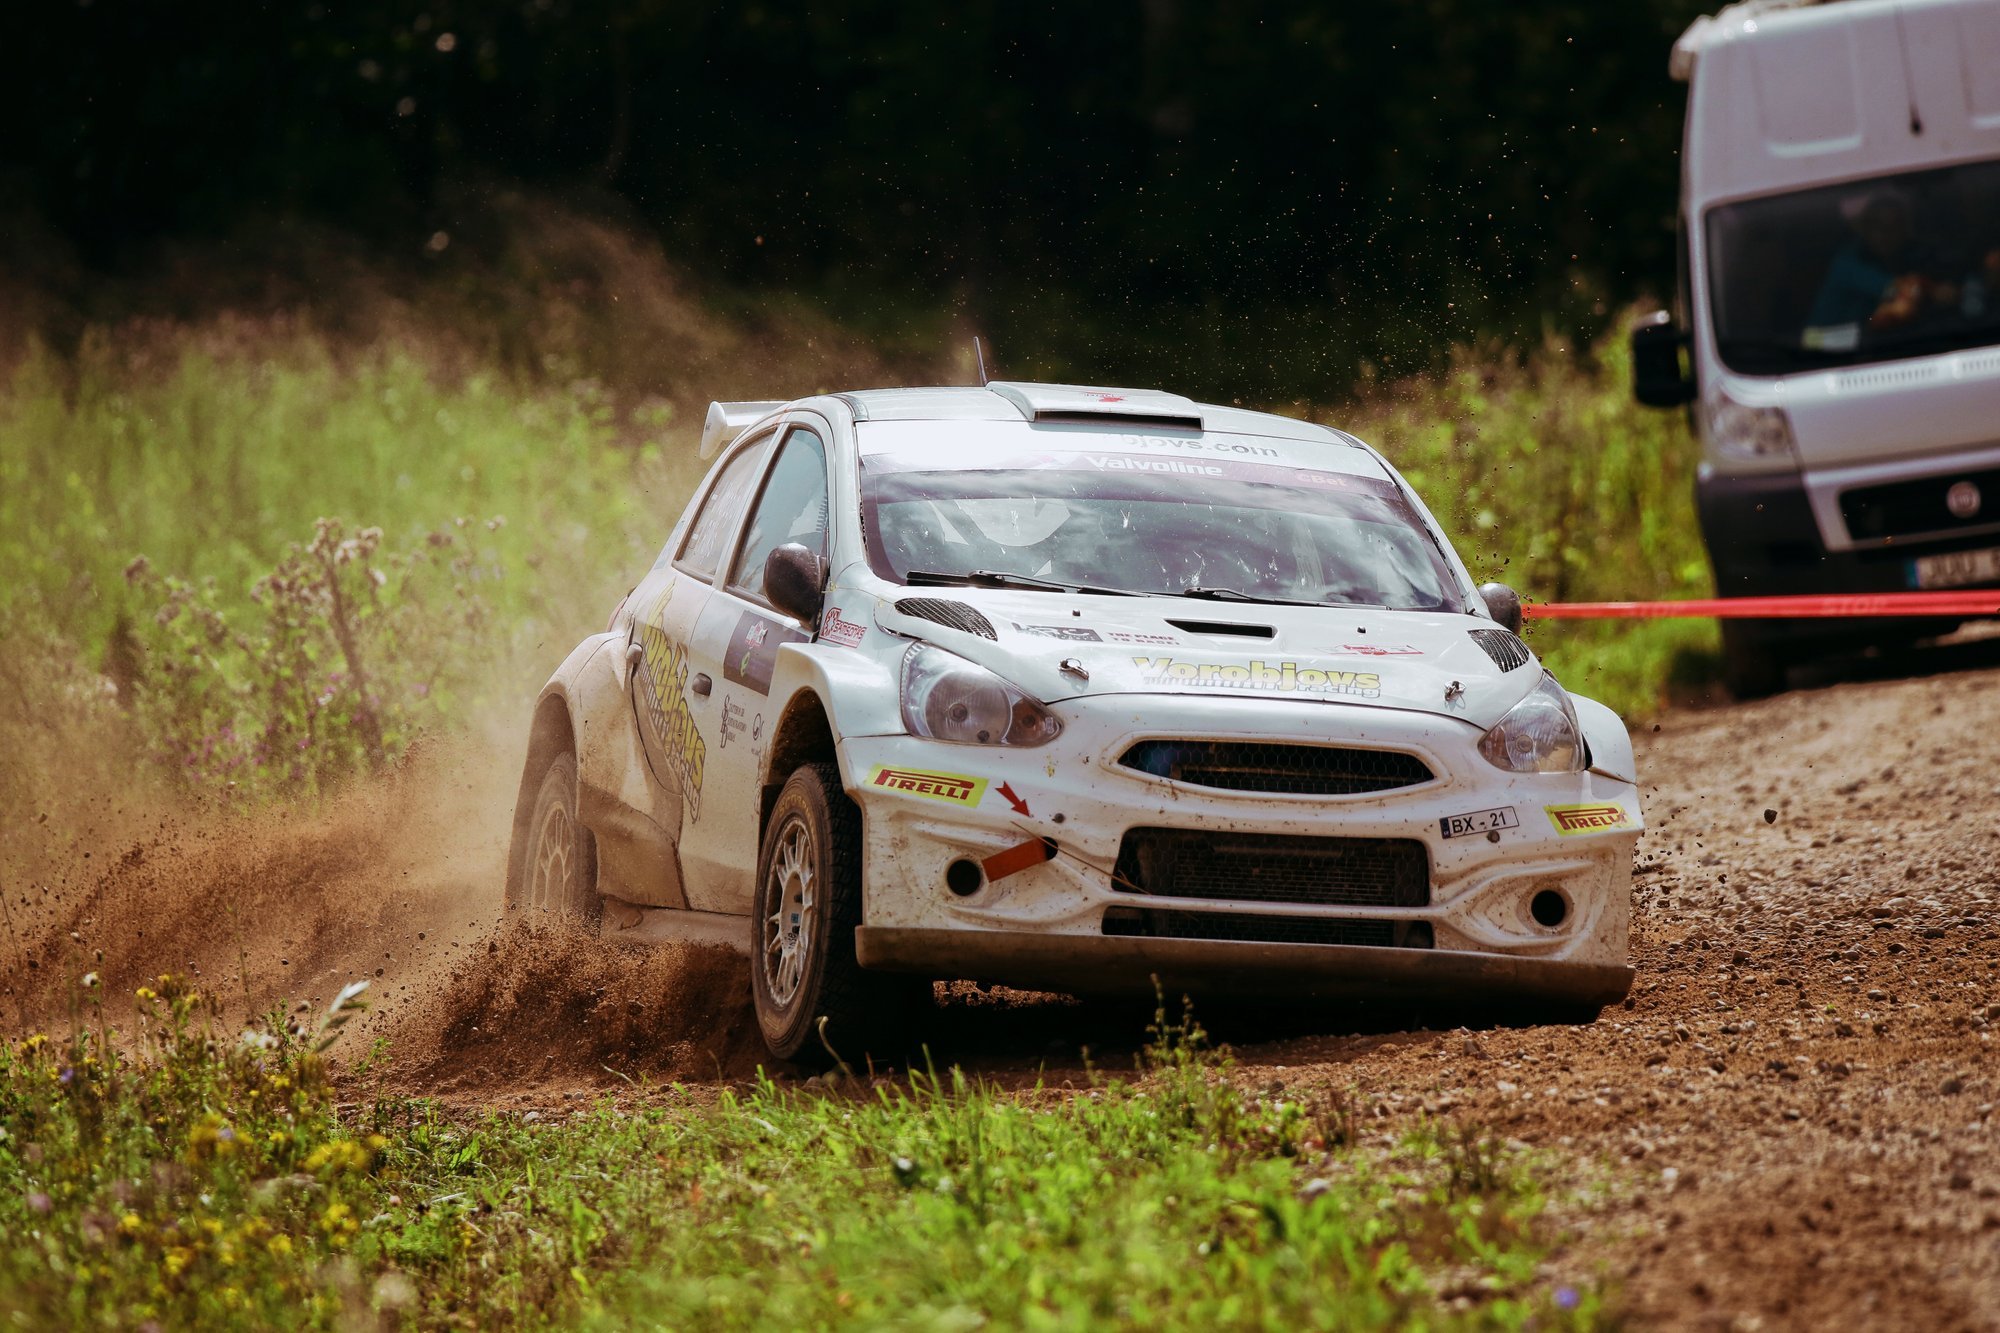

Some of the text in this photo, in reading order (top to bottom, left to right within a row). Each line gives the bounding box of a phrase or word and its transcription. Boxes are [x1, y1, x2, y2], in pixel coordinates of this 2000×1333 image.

[1084, 455, 1223, 477] Valvoline
[1132, 656, 1381, 691] Vorobjovs
[1297, 684, 1381, 699] racing
[874, 769, 975, 801] PIRELLI
[1452, 816, 1475, 833] BX
[1490, 811, 1506, 827] 21
[1553, 807, 1625, 831] PIREL
